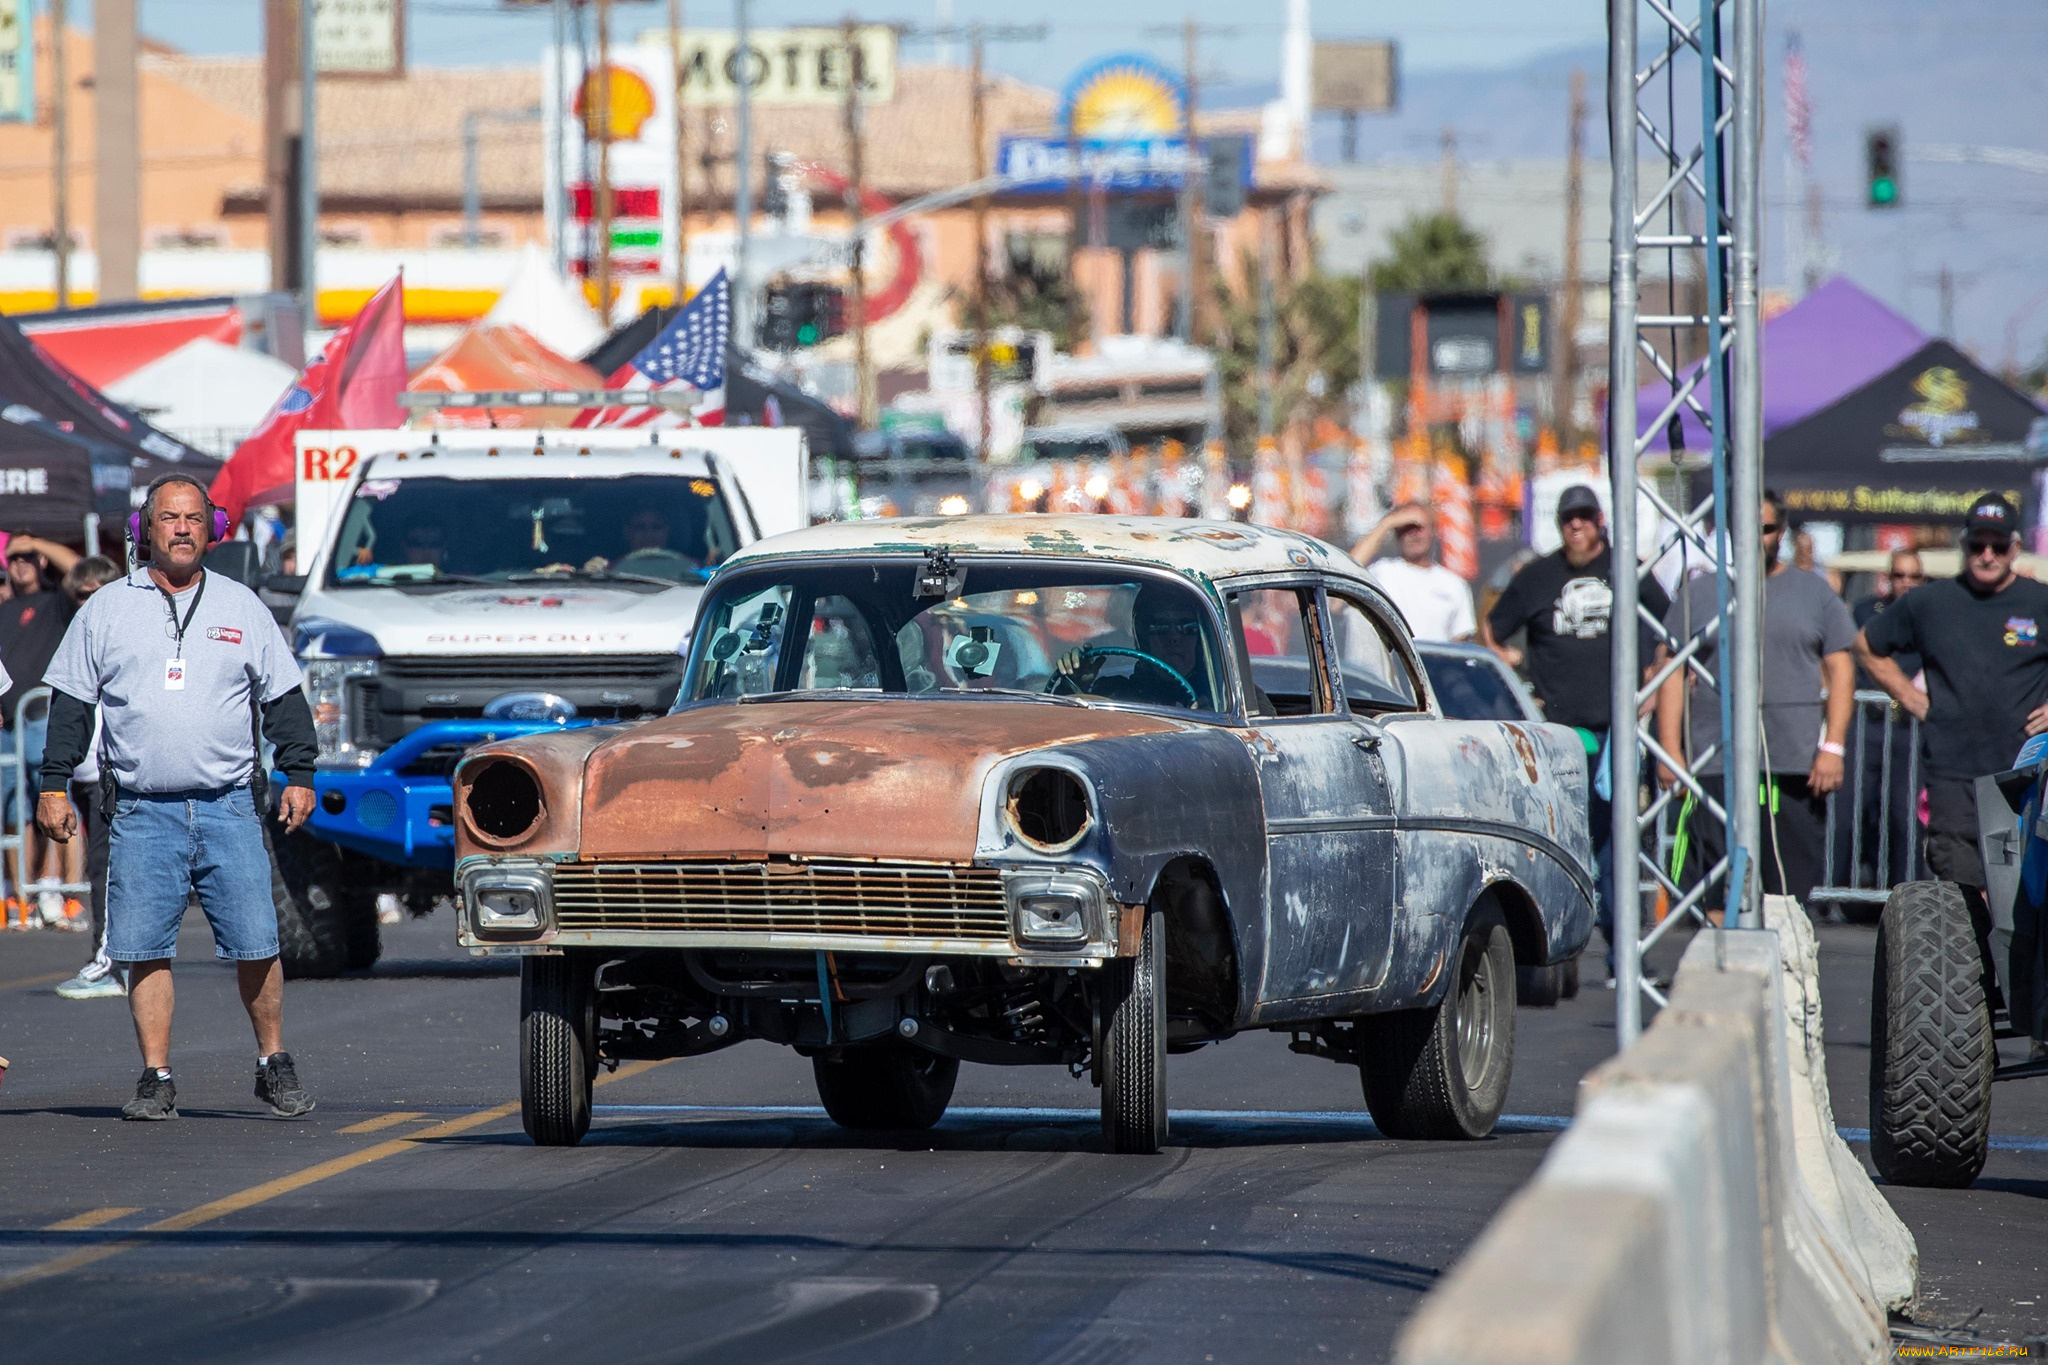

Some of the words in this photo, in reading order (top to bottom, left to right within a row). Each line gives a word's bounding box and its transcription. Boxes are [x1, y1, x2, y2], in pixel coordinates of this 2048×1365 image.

[304, 447, 357, 480] R2
[427, 633, 538, 643] SUPER
[547, 632, 632, 643] DUTY
